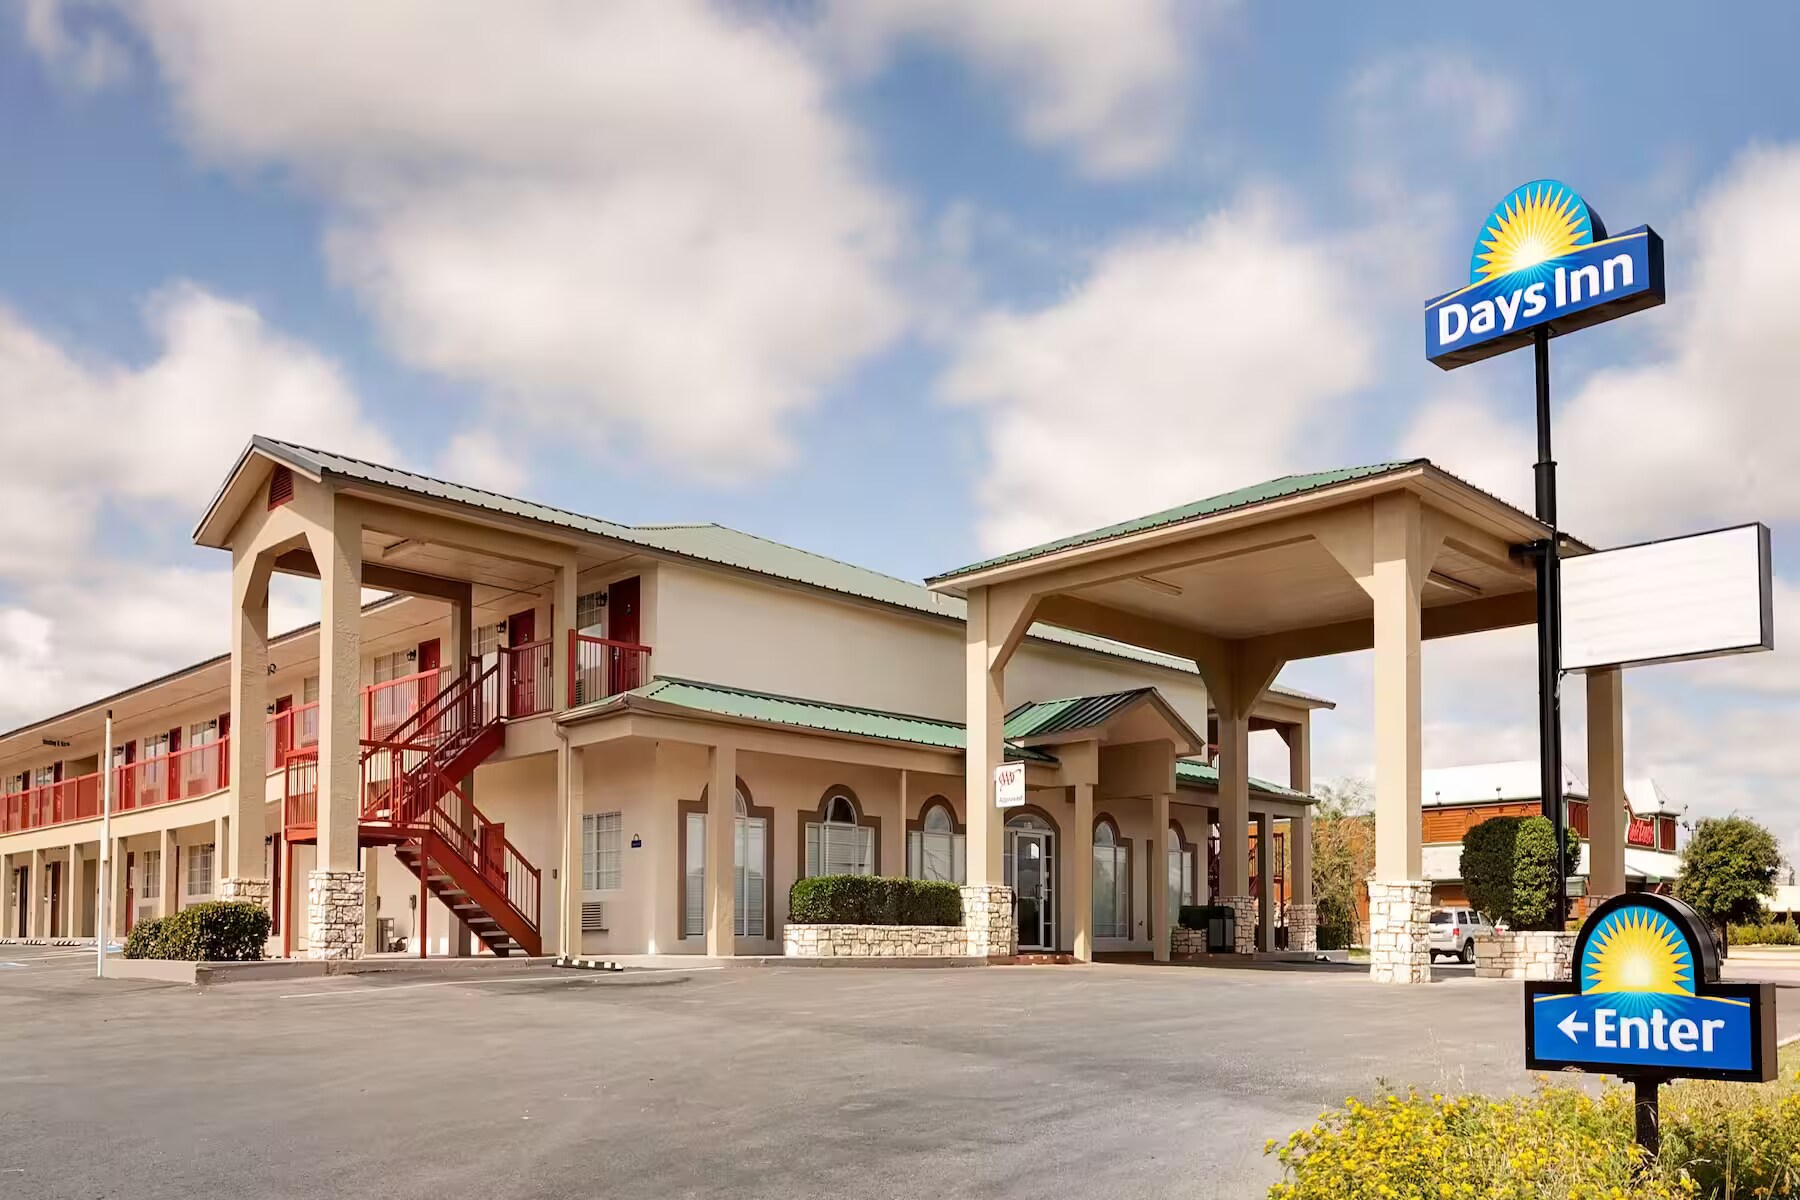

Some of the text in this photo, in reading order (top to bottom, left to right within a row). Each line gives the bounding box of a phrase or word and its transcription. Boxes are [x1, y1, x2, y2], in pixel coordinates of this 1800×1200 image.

[1438, 253, 1634, 346] Days Inn
[1594, 1008, 1726, 1053] Enter
